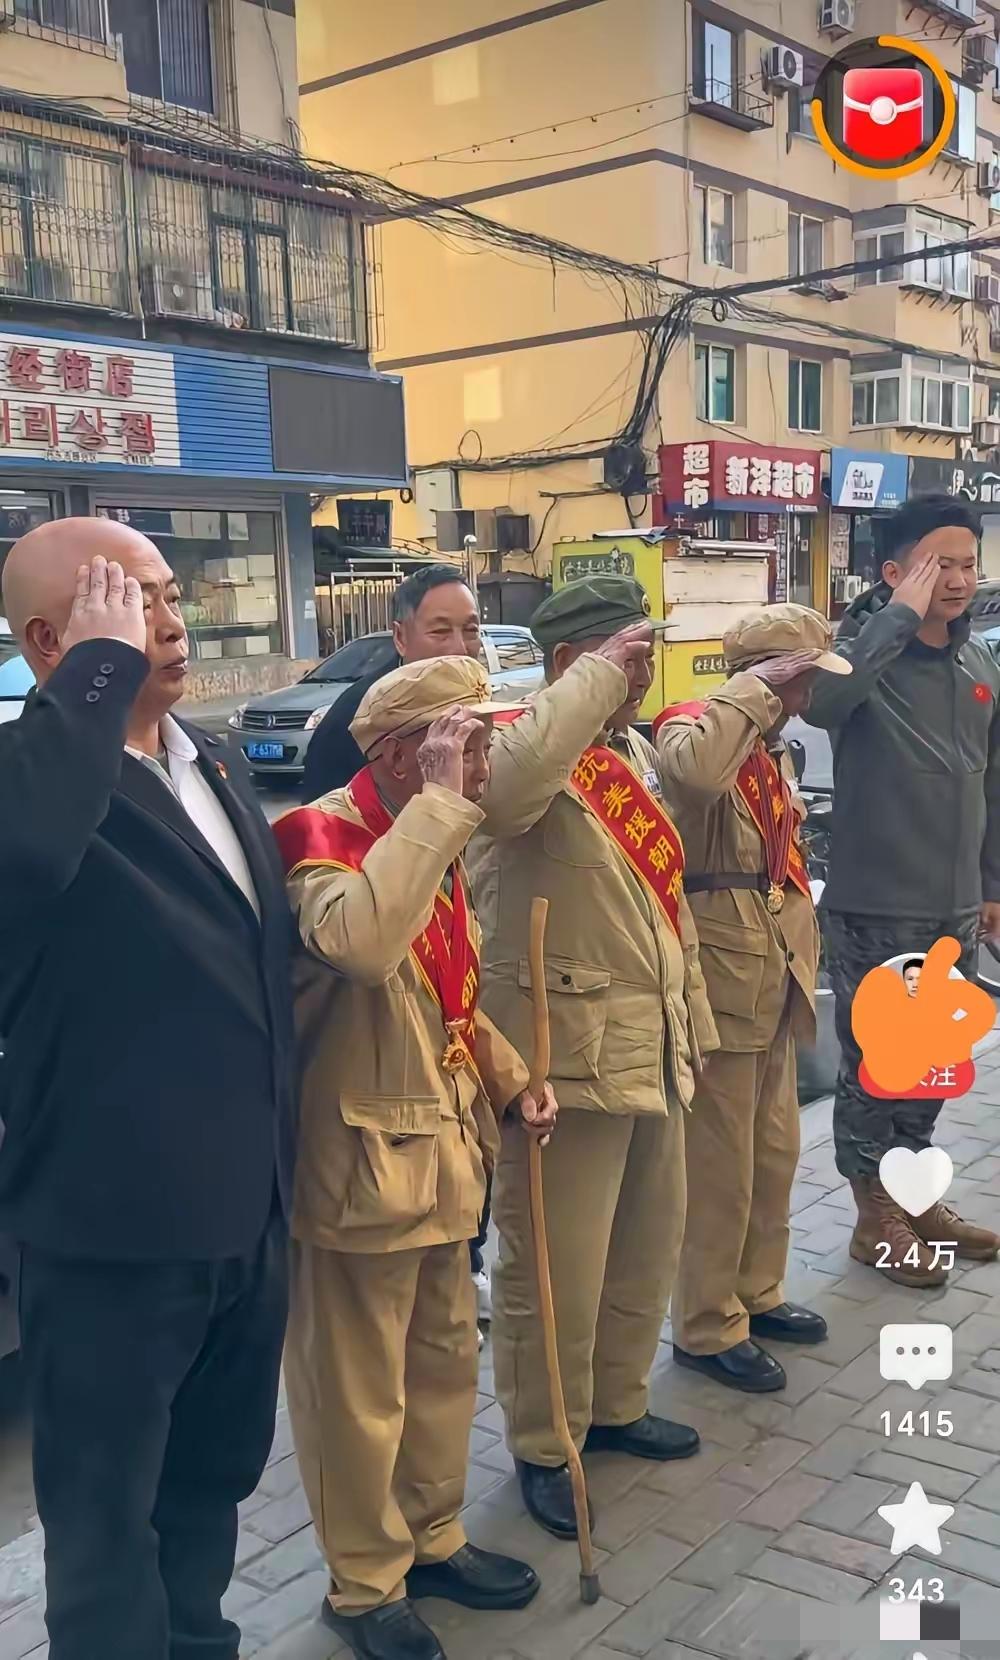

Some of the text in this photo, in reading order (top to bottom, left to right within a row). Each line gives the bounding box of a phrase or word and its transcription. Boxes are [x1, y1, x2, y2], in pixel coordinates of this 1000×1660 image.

[683, 443, 710, 509] 超市
[726, 456, 815, 498] 新泽超市
